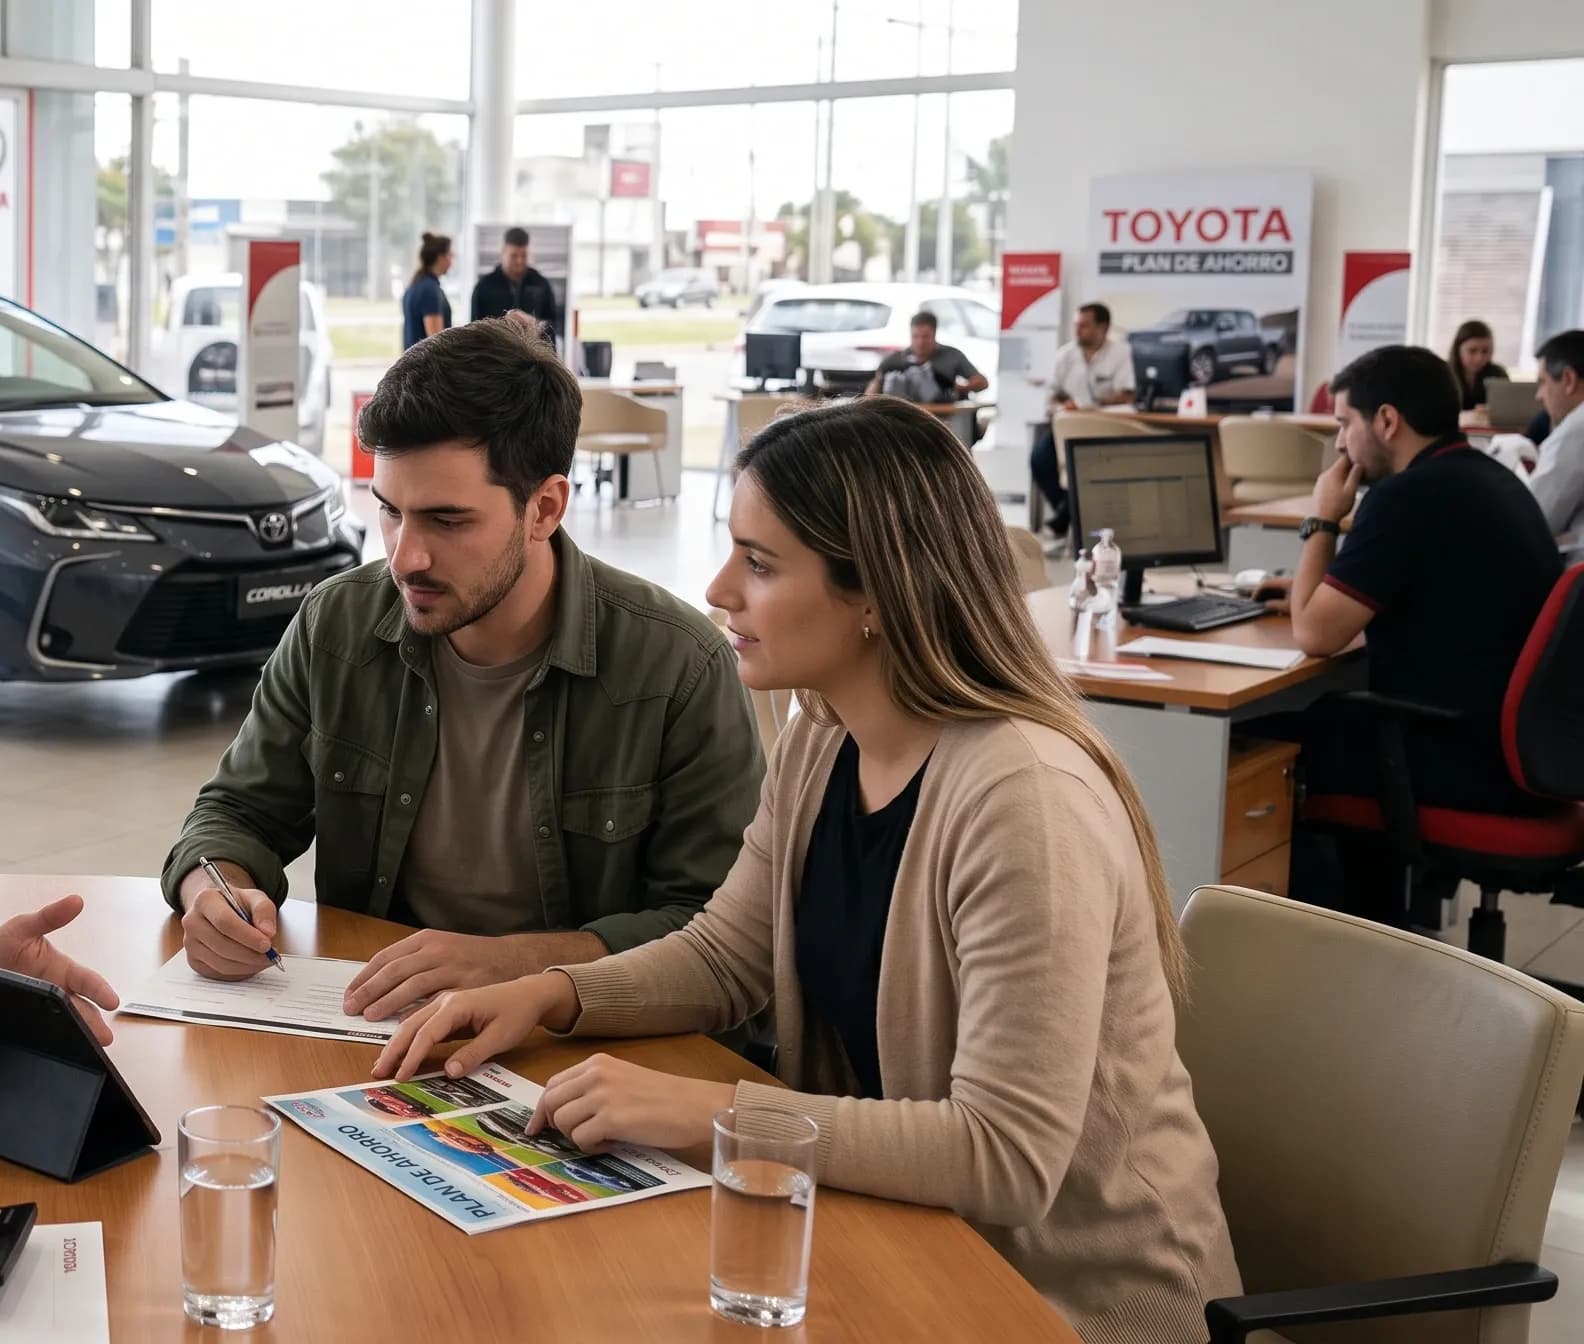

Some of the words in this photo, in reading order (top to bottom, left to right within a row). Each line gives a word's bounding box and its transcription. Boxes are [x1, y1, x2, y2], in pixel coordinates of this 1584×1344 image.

[1103, 207, 1292, 243] TOYOTA
[1122, 254, 1171, 272] PLAN
[1173, 254, 1200, 271] DE
[1202, 253, 1288, 271] AHORRO
[337, 1124, 420, 1169] AHORRO
[409, 1167, 447, 1187] DE
[434, 1184, 496, 1219] PLAN
